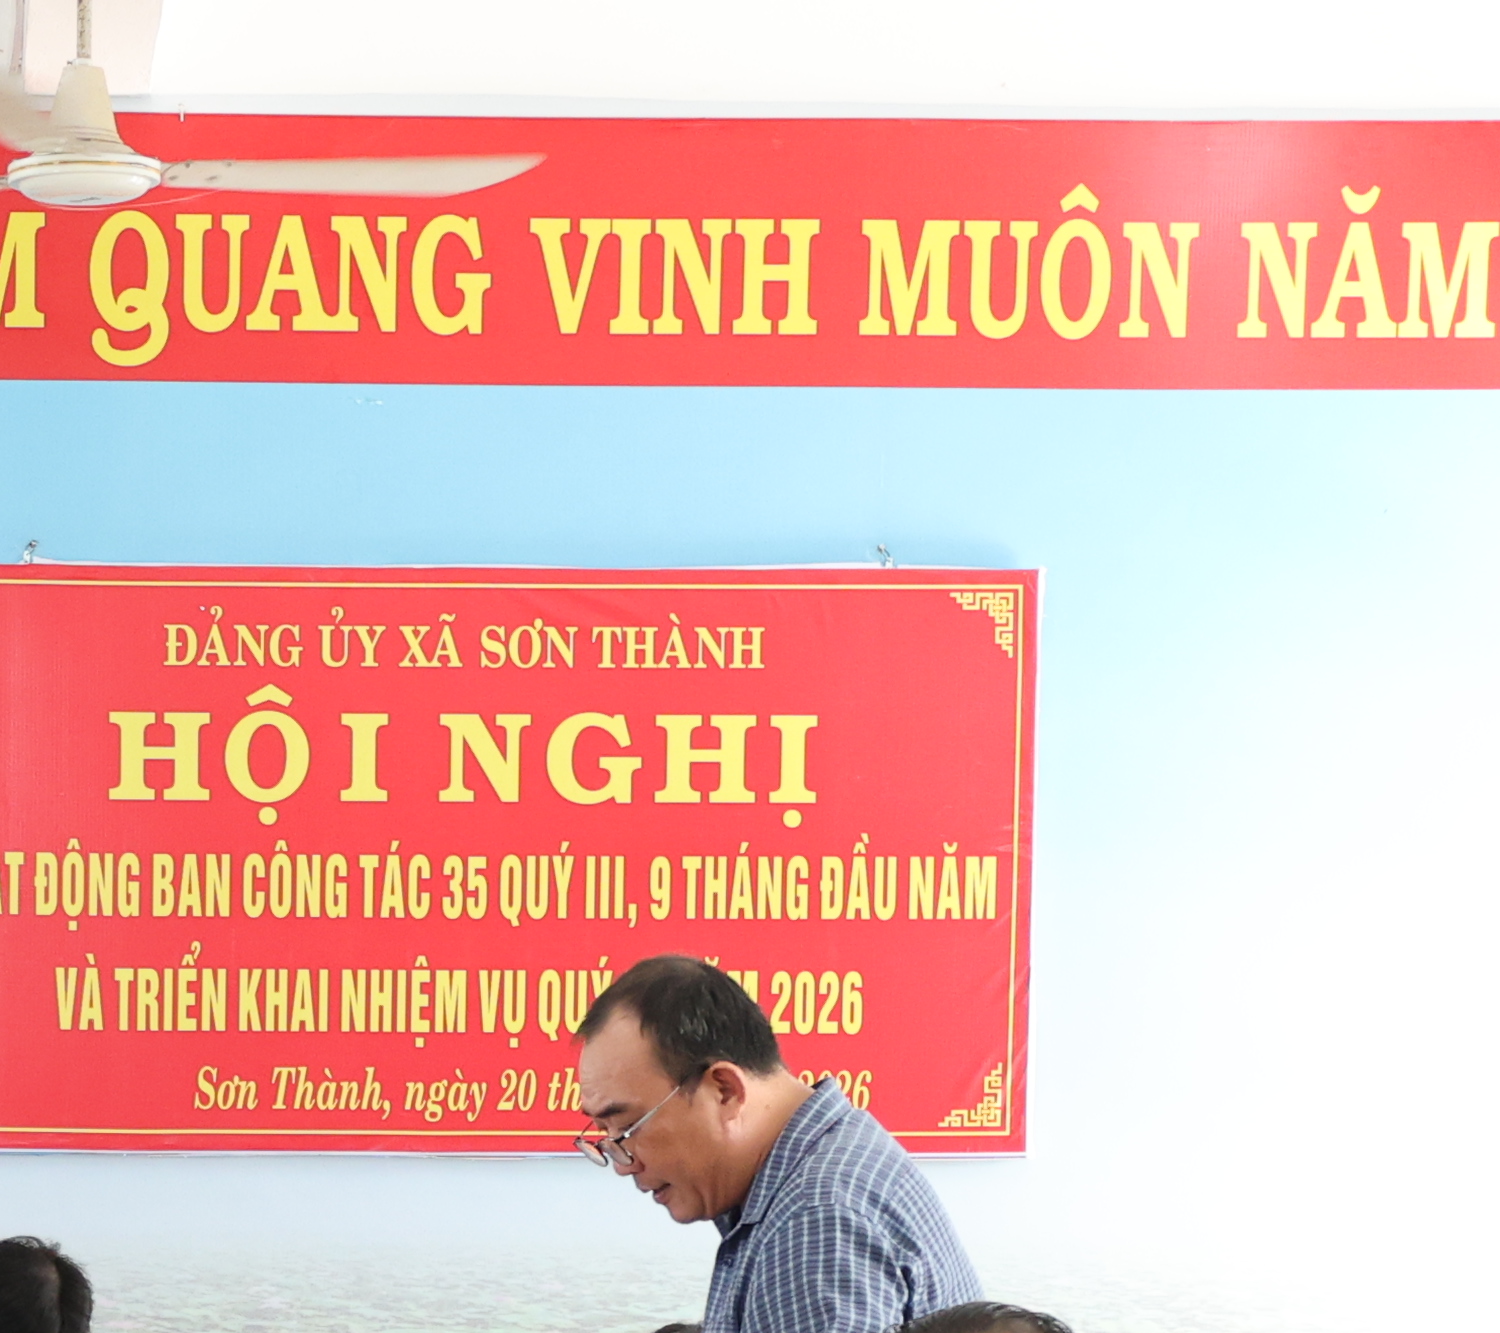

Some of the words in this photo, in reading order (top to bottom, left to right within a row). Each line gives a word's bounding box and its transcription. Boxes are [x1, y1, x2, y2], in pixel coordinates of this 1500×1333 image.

[87, 210, 491, 366] QUANG
[529, 216, 820, 335] VINH
[858, 183, 1199, 340] MUÔN
[1237, 185, 1499, 338] NĂM
[164, 606, 303, 668] ĐẢNG
[319, 606, 386, 668] ỦY
[399, 614, 462, 668] XÃ
[480, 619, 579, 669] SƠN
[591, 613, 765, 669] THÀNH
[108, 684, 389, 825] HỘI
[438, 712, 818, 828] NGHỊ
[34, 839, 140, 930] ĐỘNG
[153, 854, 230, 917] BAN
[242, 840, 349, 919] CÔNG
[360, 841, 430, 920] TÁC
[443, 855, 488, 919] 35
[500, 842, 574, 927] QUÝ
[585, 856, 639, 927] III,
[649, 856, 672, 920] 9
[682, 842, 809, 921] THÁNG
[820, 833, 896, 921] ĐẦU
[908, 841, 997, 920] NĂM
[55, 953, 103, 1031] VÀ
[115, 940, 227, 1032] TRIỂN
[239, 968, 329, 1032] KHAI
[341, 955, 467, 1047] NHIỆM
[479, 970, 526, 1047] VỤ
[771, 970, 863, 1035] 2026
[194, 1066, 263, 1110] Sơn
[272, 1067, 390, 1119] Thành,
[405, 1075, 487, 1122] ngày
[497, 1069, 537, 1111] 20
